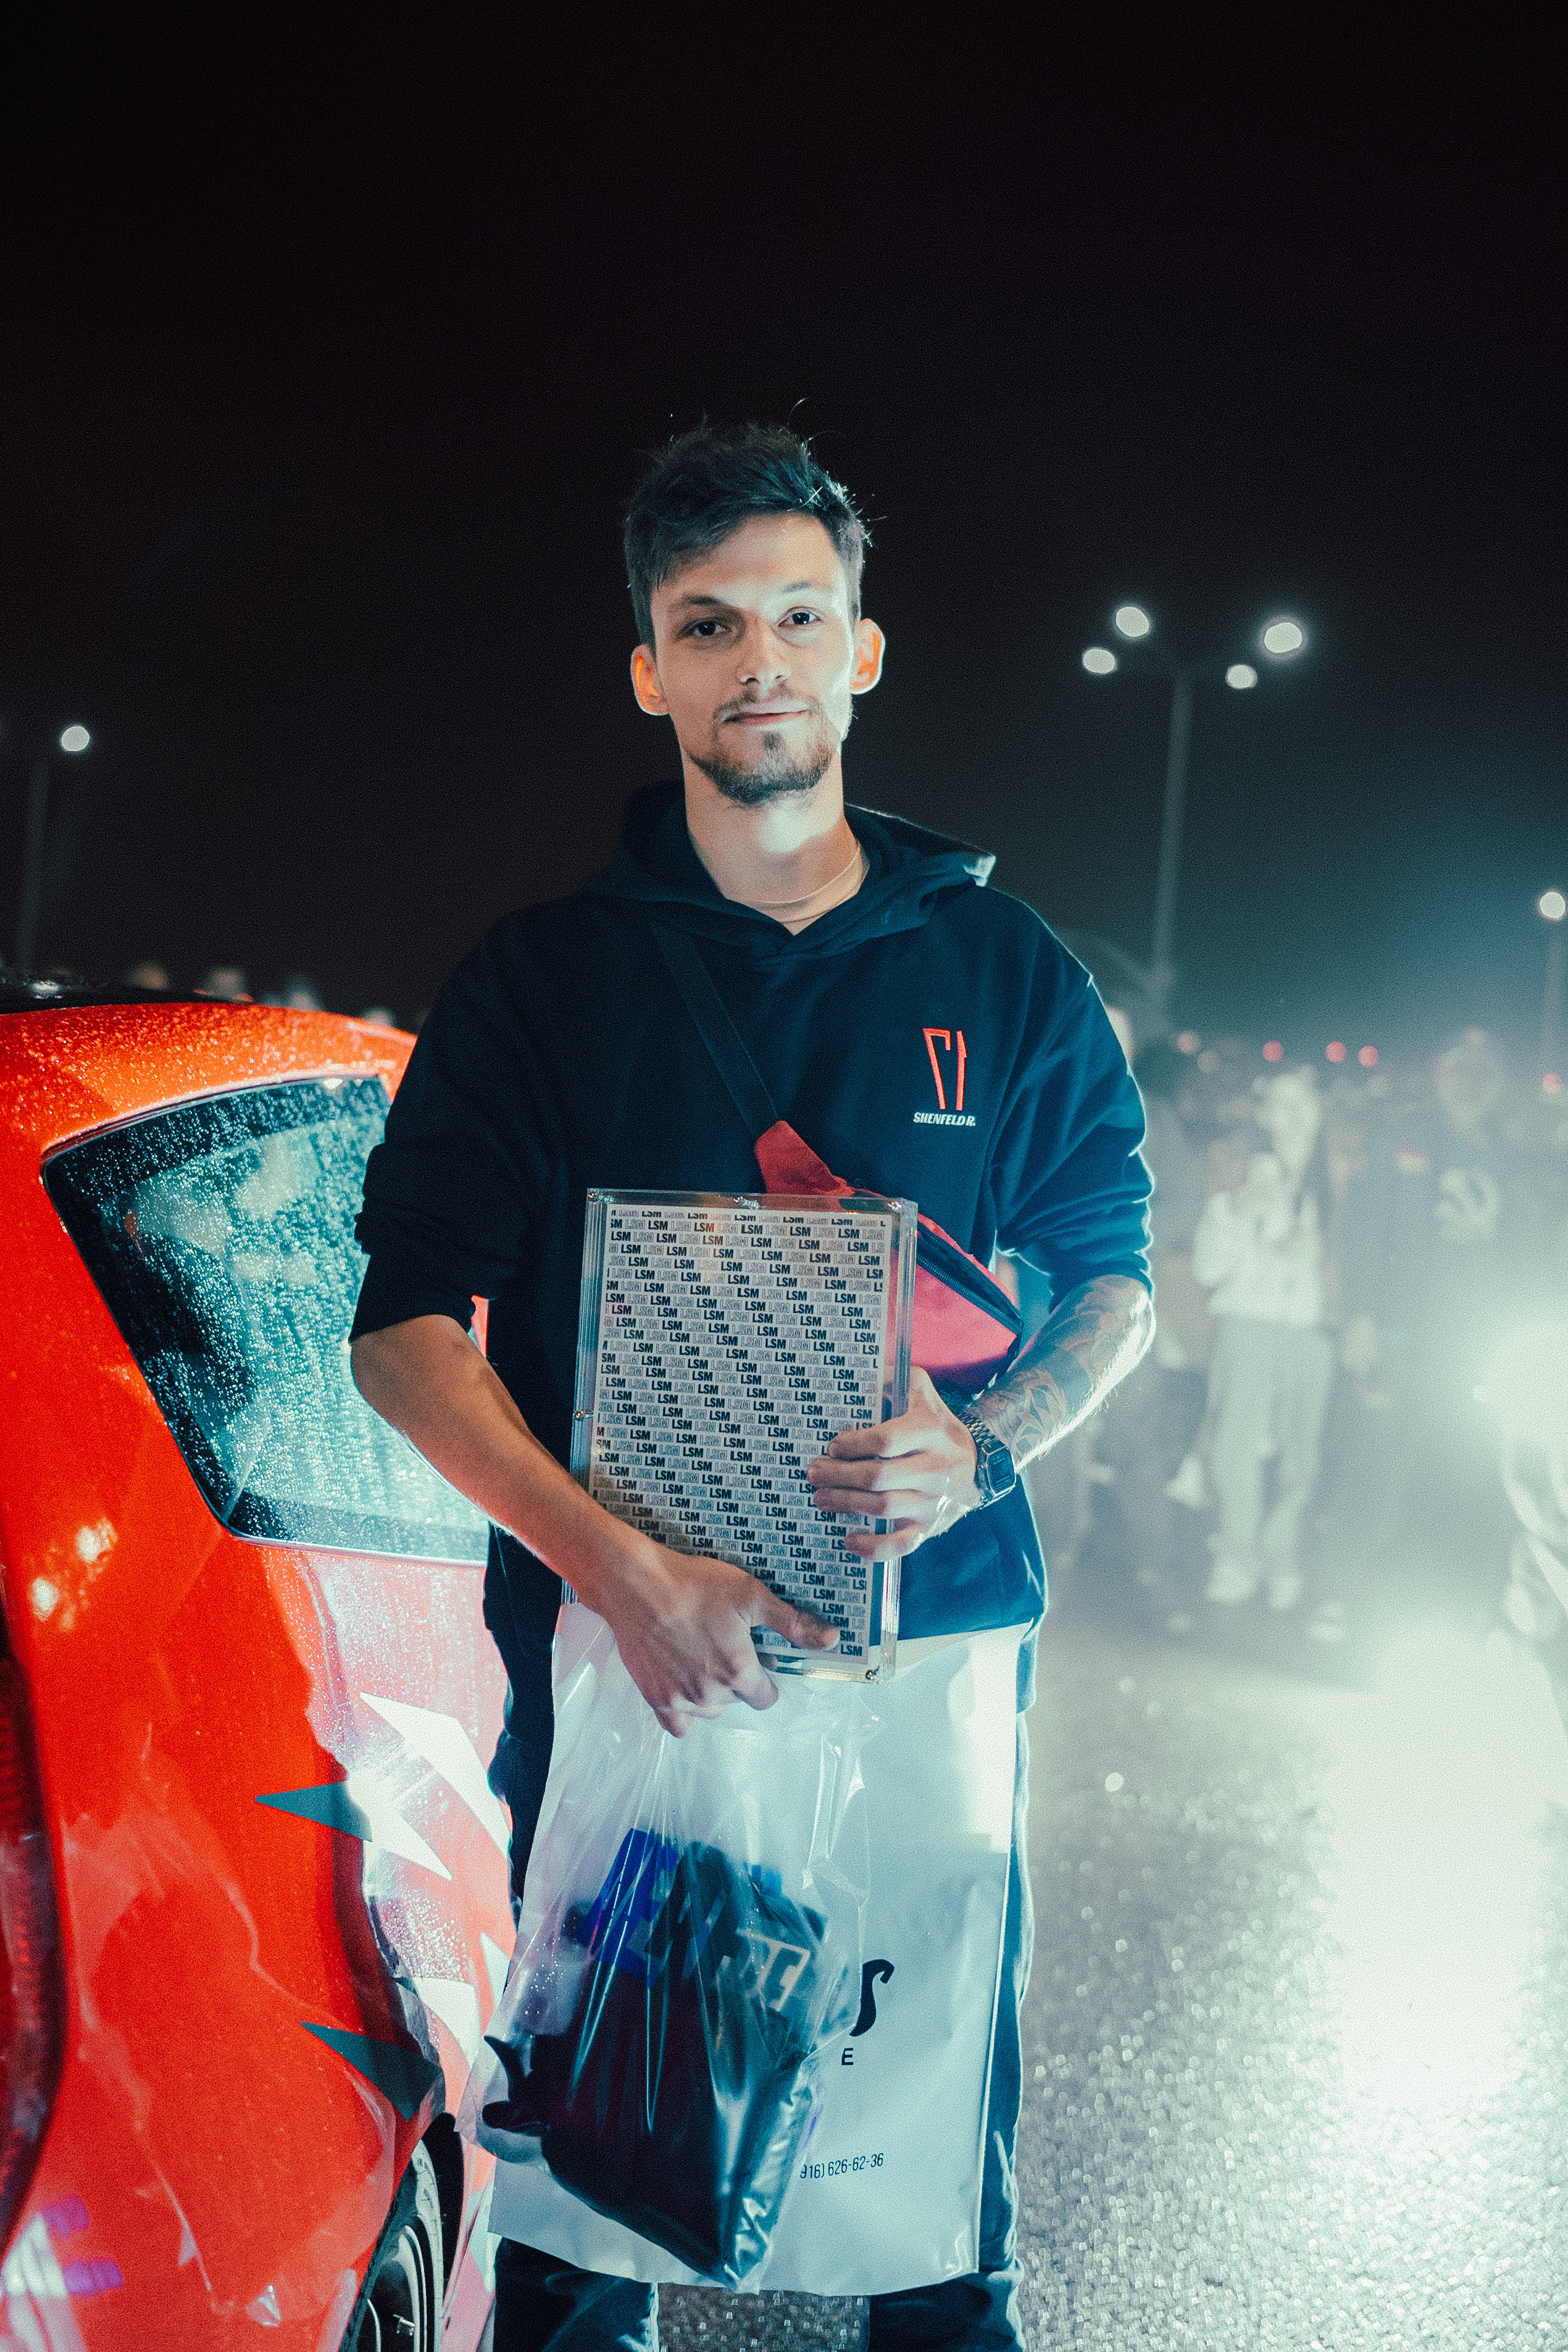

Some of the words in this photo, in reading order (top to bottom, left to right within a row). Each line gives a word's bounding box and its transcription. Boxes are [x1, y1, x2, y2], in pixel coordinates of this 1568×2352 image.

[648, 1220, 668, 1230] LSM
[694, 1222, 714, 1232] LSM
[742, 1225, 762, 1234] LSM
[790, 1227, 810, 1236] LSM
[838, 1228, 859, 1238] LSM
[611, 1231, 631, 1241] LSM
[656, 1233, 677, 1243] LSM
[703, 1235, 723, 1245] LSM
[751, 1238, 771, 1247] LSM
[799, 1240, 819, 1249] LSM
[848, 1242, 868, 1252] LSM
[620, 1244, 641, 1254] LSM
[667, 1246, 686, 1256] LSM
[713, 1248, 733, 1258] LSM
[761, 1251, 782, 1261] LSM
[810, 1253, 830, 1263] LSM
[859, 1256, 879, 1266] LSM
[628, 1257, 648, 1267] LSM
[674, 1259, 694, 1269] LSM
[720, 1261, 741, 1271] LSM
[769, 1264, 790, 1274] LSM
[818, 1267, 838, 1277] LSM
[635, 1270, 655, 1280] LSM
[681, 1272, 701, 1282] LSM
[728, 1275, 748, 1285] LSM
[777, 1277, 797, 1287] LSM
[825, 1280, 846, 1290] LSM
[644, 1283, 664, 1293] LSM
[690, 1285, 711, 1295] LSM
[738, 1288, 759, 1298] LSM
[786, 1290, 807, 1301] LSM
[835, 1293, 856, 1303] LSM
[606, 1293, 625, 1303] LSM
[650, 1295, 670, 1306] LSM
[696, 1298, 717, 1308] LSM
[745, 1301, 765, 1311] LSM
[793, 1304, 814, 1314] LSM
[841, 1307, 862, 1317] LSM
[611, 1304, 632, 1315] LSM
[657, 1307, 677, 1317] LSM
[704, 1310, 724, 1320] LSM
[752, 1313, 773, 1323] LSM
[800, 1316, 821, 1326] LSM
[849, 1319, 870, 1329] LSM
[616, 1317, 636, 1327] LSM
[662, 1320, 682, 1330] LSM
[708, 1323, 729, 1333] LSM
[757, 1326, 778, 1337] LSM
[806, 1329, 826, 1340] LSM
[854, 1332, 875, 1343] LSM
[623, 1329, 644, 1339] LSM
[669, 1332, 690, 1343] LSM
[716, 1335, 737, 1345] LSM
[765, 1338, 786, 1349] LSM
[814, 1341, 834, 1352] LSM
[633, 1342, 653, 1353] LSM
[679, 1346, 699, 1356] LSM
[727, 1349, 747, 1359] LSM
[775, 1352, 796, 1362] LSM
[824, 1356, 844, 1366] LSM
[600, 1364, 620, 1374] LSM
[646, 1367, 666, 1378] LSM
[692, 1370, 712, 1381] LSM
[740, 1374, 761, 1385] LSM
[789, 1378, 809, 1388] LSM
[838, 1381, 859, 1391] LSM
[641, 1356, 662, 1366] LSM
[688, 1359, 708, 1369] LSM
[736, 1362, 757, 1372] LSM
[784, 1366, 804, 1376] LSM
[833, 1369, 854, 1380] LSM
[606, 1377, 626, 1388] LSM
[651, 1381, 672, 1391] LSM
[698, 1384, 719, 1395] LSM
[746, 1388, 767, 1398] LSM
[794, 1391, 815, 1402] LSM
[844, 1395, 865, 1405] LSM
[611, 1390, 632, 1401] LSM
[657, 1394, 678, 1404] LSM
[704, 1397, 725, 1407] LSM
[753, 1401, 774, 1412] LSM
[801, 1405, 822, 1416] LSM
[851, 1409, 872, 1419] LSM
[616, 1403, 636, 1414] LSM
[662, 1407, 683, 1417] LSM
[709, 1411, 730, 1421] LSM
[758, 1414, 779, 1425] LSM
[807, 1418, 828, 1429] LSM
[625, 1416, 646, 1426] LSM
[672, 1419, 692, 1430] LSM
[719, 1423, 740, 1433] LSM
[767, 1427, 788, 1438] LSM
[630, 1430, 650, 1440] LSM
[676, 1433, 697, 1444] LSM
[724, 1437, 744, 1448] LSM
[772, 1441, 793, 1452] LSM
[636, 1443, 657, 1453] LSM
[683, 1447, 703, 1457] LSM
[731, 1451, 752, 1462] LSM
[779, 1455, 800, 1466] LSM
[644, 1456, 665, 1467] LSM
[691, 1461, 712, 1471] LSM
[740, 1465, 761, 1475] LSM
[609, 1466, 630, 1477] LSM
[654, 1470, 675, 1481] LSM
[702, 1474, 723, 1485] LSM
[751, 1478, 772, 1490] LSM
[616, 1479, 637, 1490] LSM
[662, 1483, 683, 1495] LSM
[709, 1488, 730, 1499] LSM
[759, 1493, 780, 1503] LSM
[622, 1493, 643, 1504] LSM
[669, 1497, 690, 1508] LSM
[717, 1502, 738, 1512] LSM
[765, 1506, 786, 1517] LSM
[632, 1506, 653, 1517] LSM
[678, 1511, 699, 1522] LSM
[727, 1516, 748, 1527] LSM
[775, 1520, 796, 1532] LSM
[825, 1525, 846, 1537] LSM
[685, 1525, 706, 1536] LSM
[734, 1530, 755, 1540] LSM
[782, 1535, 804, 1546] LSM
[741, 1542, 762, 1553] LSM
[790, 1547, 811, 1558] LSM
[746, 1556, 767, 1567] LSM
[794, 1561, 816, 1572] LSM
[844, 1566, 865, 1577] LSM
[803, 1574, 825, 1585] LSM
[814, 1588, 835, 1600] LSM
[822, 1603, 844, 1614] LSM
[840, 1644, 862, 1656] LSM
[841, 2048, 853, 2066] E
[828, 2153, 884, 2176] 626-62-36
